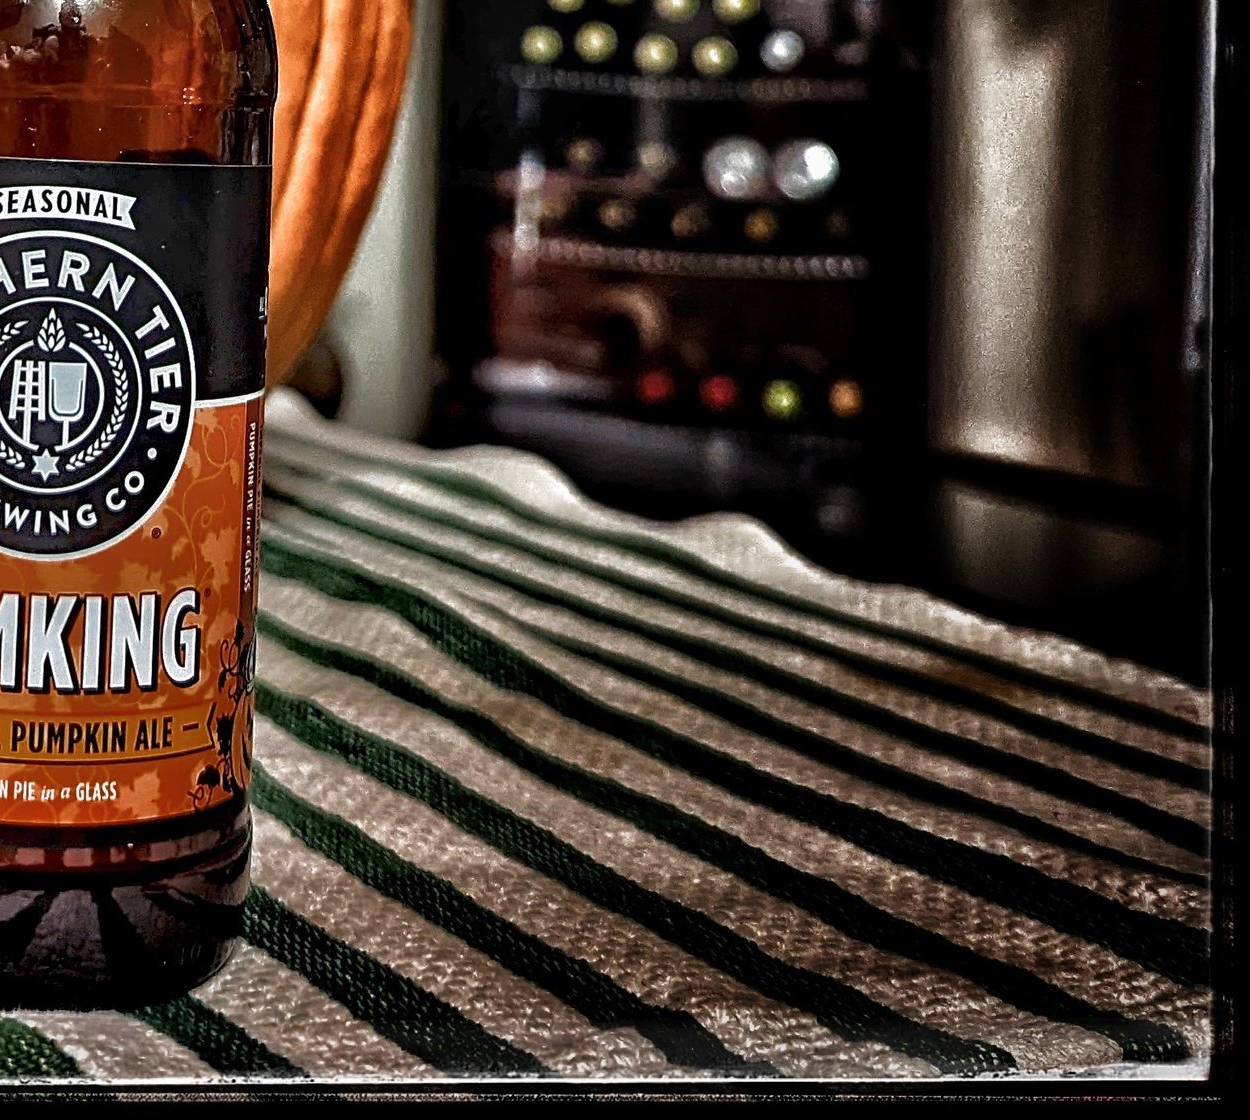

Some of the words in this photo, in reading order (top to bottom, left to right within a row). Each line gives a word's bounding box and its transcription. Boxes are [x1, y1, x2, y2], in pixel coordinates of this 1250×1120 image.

[134, 305, 183, 433] TIER
[247, 422, 256, 485] PUMPKIN
[105, 470, 145, 511] CO
[246, 489, 254, 512] PIE
[244, 549, 252, 592] GLASS
[10, 719, 127, 754] PUMPKIN
[134, 716, 173, 751] ALE
[13, 780, 36, 801] PIE
[40, 785, 55, 801] in
[60, 786, 71, 800] a
[75, 781, 117, 801] GLASS
